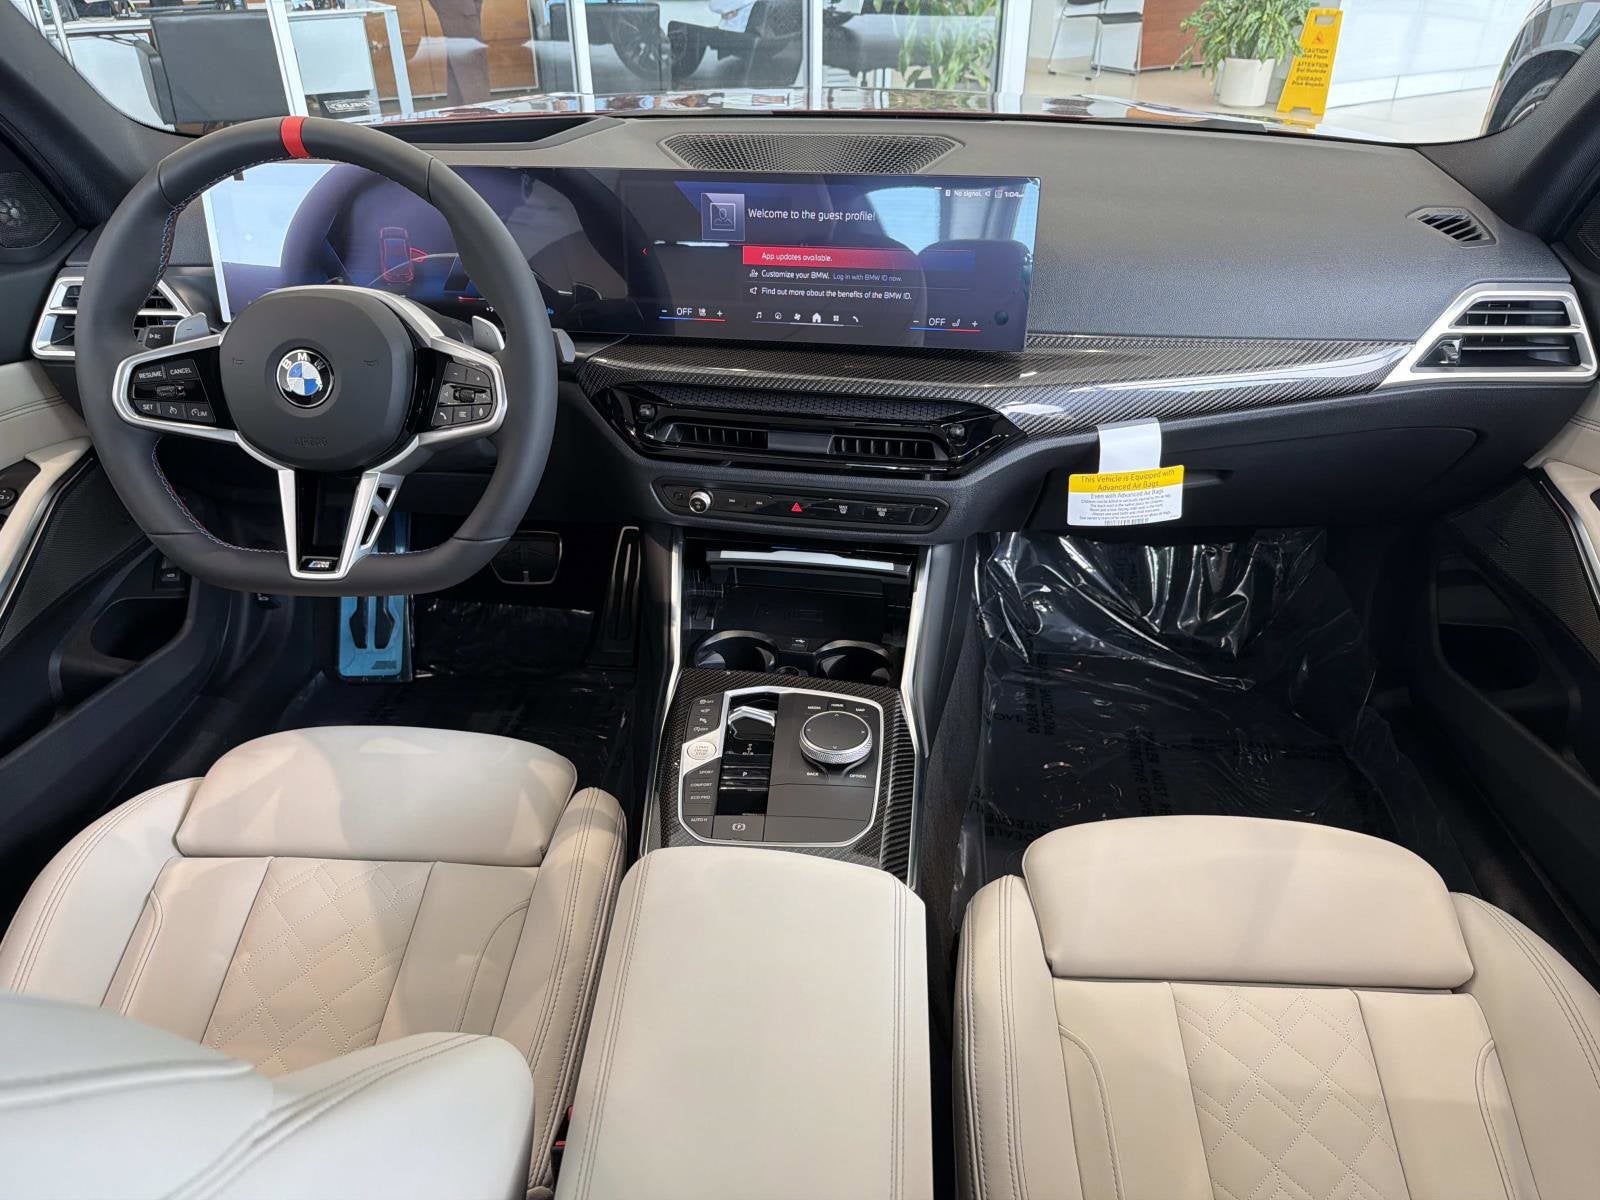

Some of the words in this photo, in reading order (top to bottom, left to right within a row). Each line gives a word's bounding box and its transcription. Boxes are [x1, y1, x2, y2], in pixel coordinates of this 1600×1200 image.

[748, 208, 788, 219] Welcome
[790, 209, 799, 219] to
[801, 209, 816, 220] the
[818, 211, 843, 222] guest
[845, 210, 876, 223] profile!
[761, 252, 775, 261] App
[776, 252, 801, 262] updates
[802, 253, 833, 263] available.
[761, 269, 795, 279] Customize
[795, 272, 810, 281] your
[810, 271, 830, 279] BMW.
[833, 273, 844, 282] Log
[864, 274, 880, 282] BMW
[761, 287, 776, 296] Find
[777, 288, 788, 296] out
[788, 289, 805, 297] more
[806, 288, 825, 298] about
[826, 290, 836, 298] the
[837, 290, 863, 299] benefits
[864, 290, 871, 299] of
[871, 291, 882, 300] the
[884, 292, 902, 300] BMW
[676, 308, 692, 316] OFF
[928, 318, 946, 327] OFF
[282, 352, 326, 370] BMW
[138, 370, 162, 380] RESUME
[1082, 475, 1096, 484] This
[1096, 474, 1122, 484] Vehicle
[1130, 471, 1160, 482] Equipped
[1162, 469, 1175, 477] with
[1097, 483, 1130, 492] Advanced
[1132, 482, 1141, 490] Air
[1144, 481, 1159, 490] Bags
